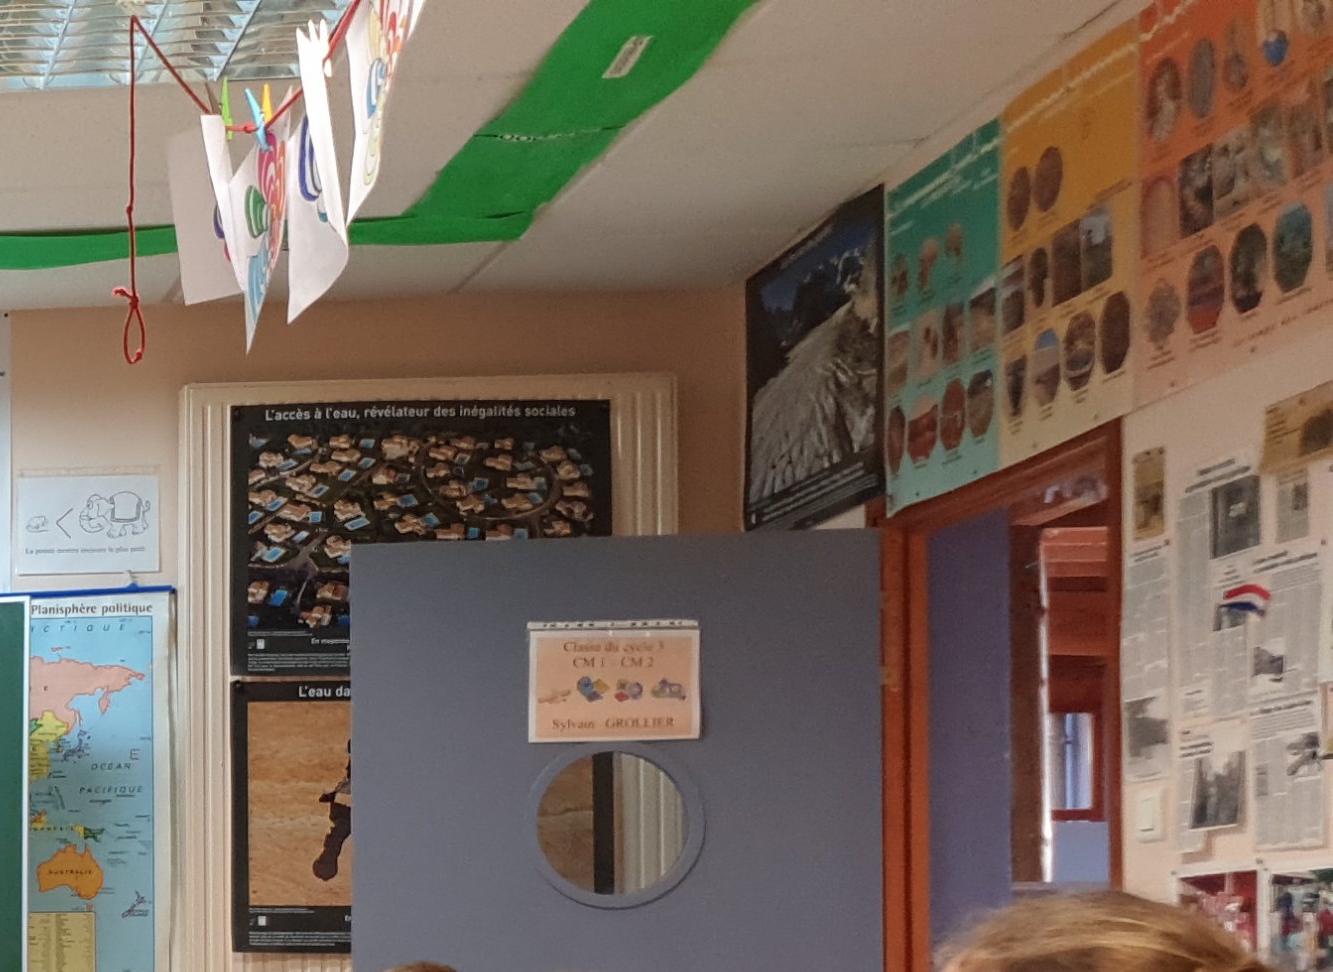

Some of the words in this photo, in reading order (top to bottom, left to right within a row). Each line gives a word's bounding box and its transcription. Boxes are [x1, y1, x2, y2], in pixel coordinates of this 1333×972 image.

[265, 408, 310, 422] L'accès
[314, 408, 322, 420] à
[325, 407, 360, 420] l'eau,
[364, 406, 429, 419] révélateur
[433, 405, 456, 418] des
[459, 404, 521, 420] inégalités
[524, 405, 576, 418] sociales
[31, 602, 97, 617] Planisphère
[101, 602, 153, 617] politique
[563, 641, 601, 652] Classe
[573, 657, 596, 668] CM
[621, 656, 643, 668] CM
[648, 657, 654, 668] 2
[298, 685, 332, 698] L'eau
[335, 685, 351, 698] da
[552, 718, 596, 731] Sylvain
[605, 716, 675, 729] GROLLIER
[79, 785, 143, 795] PACIFIQUE
